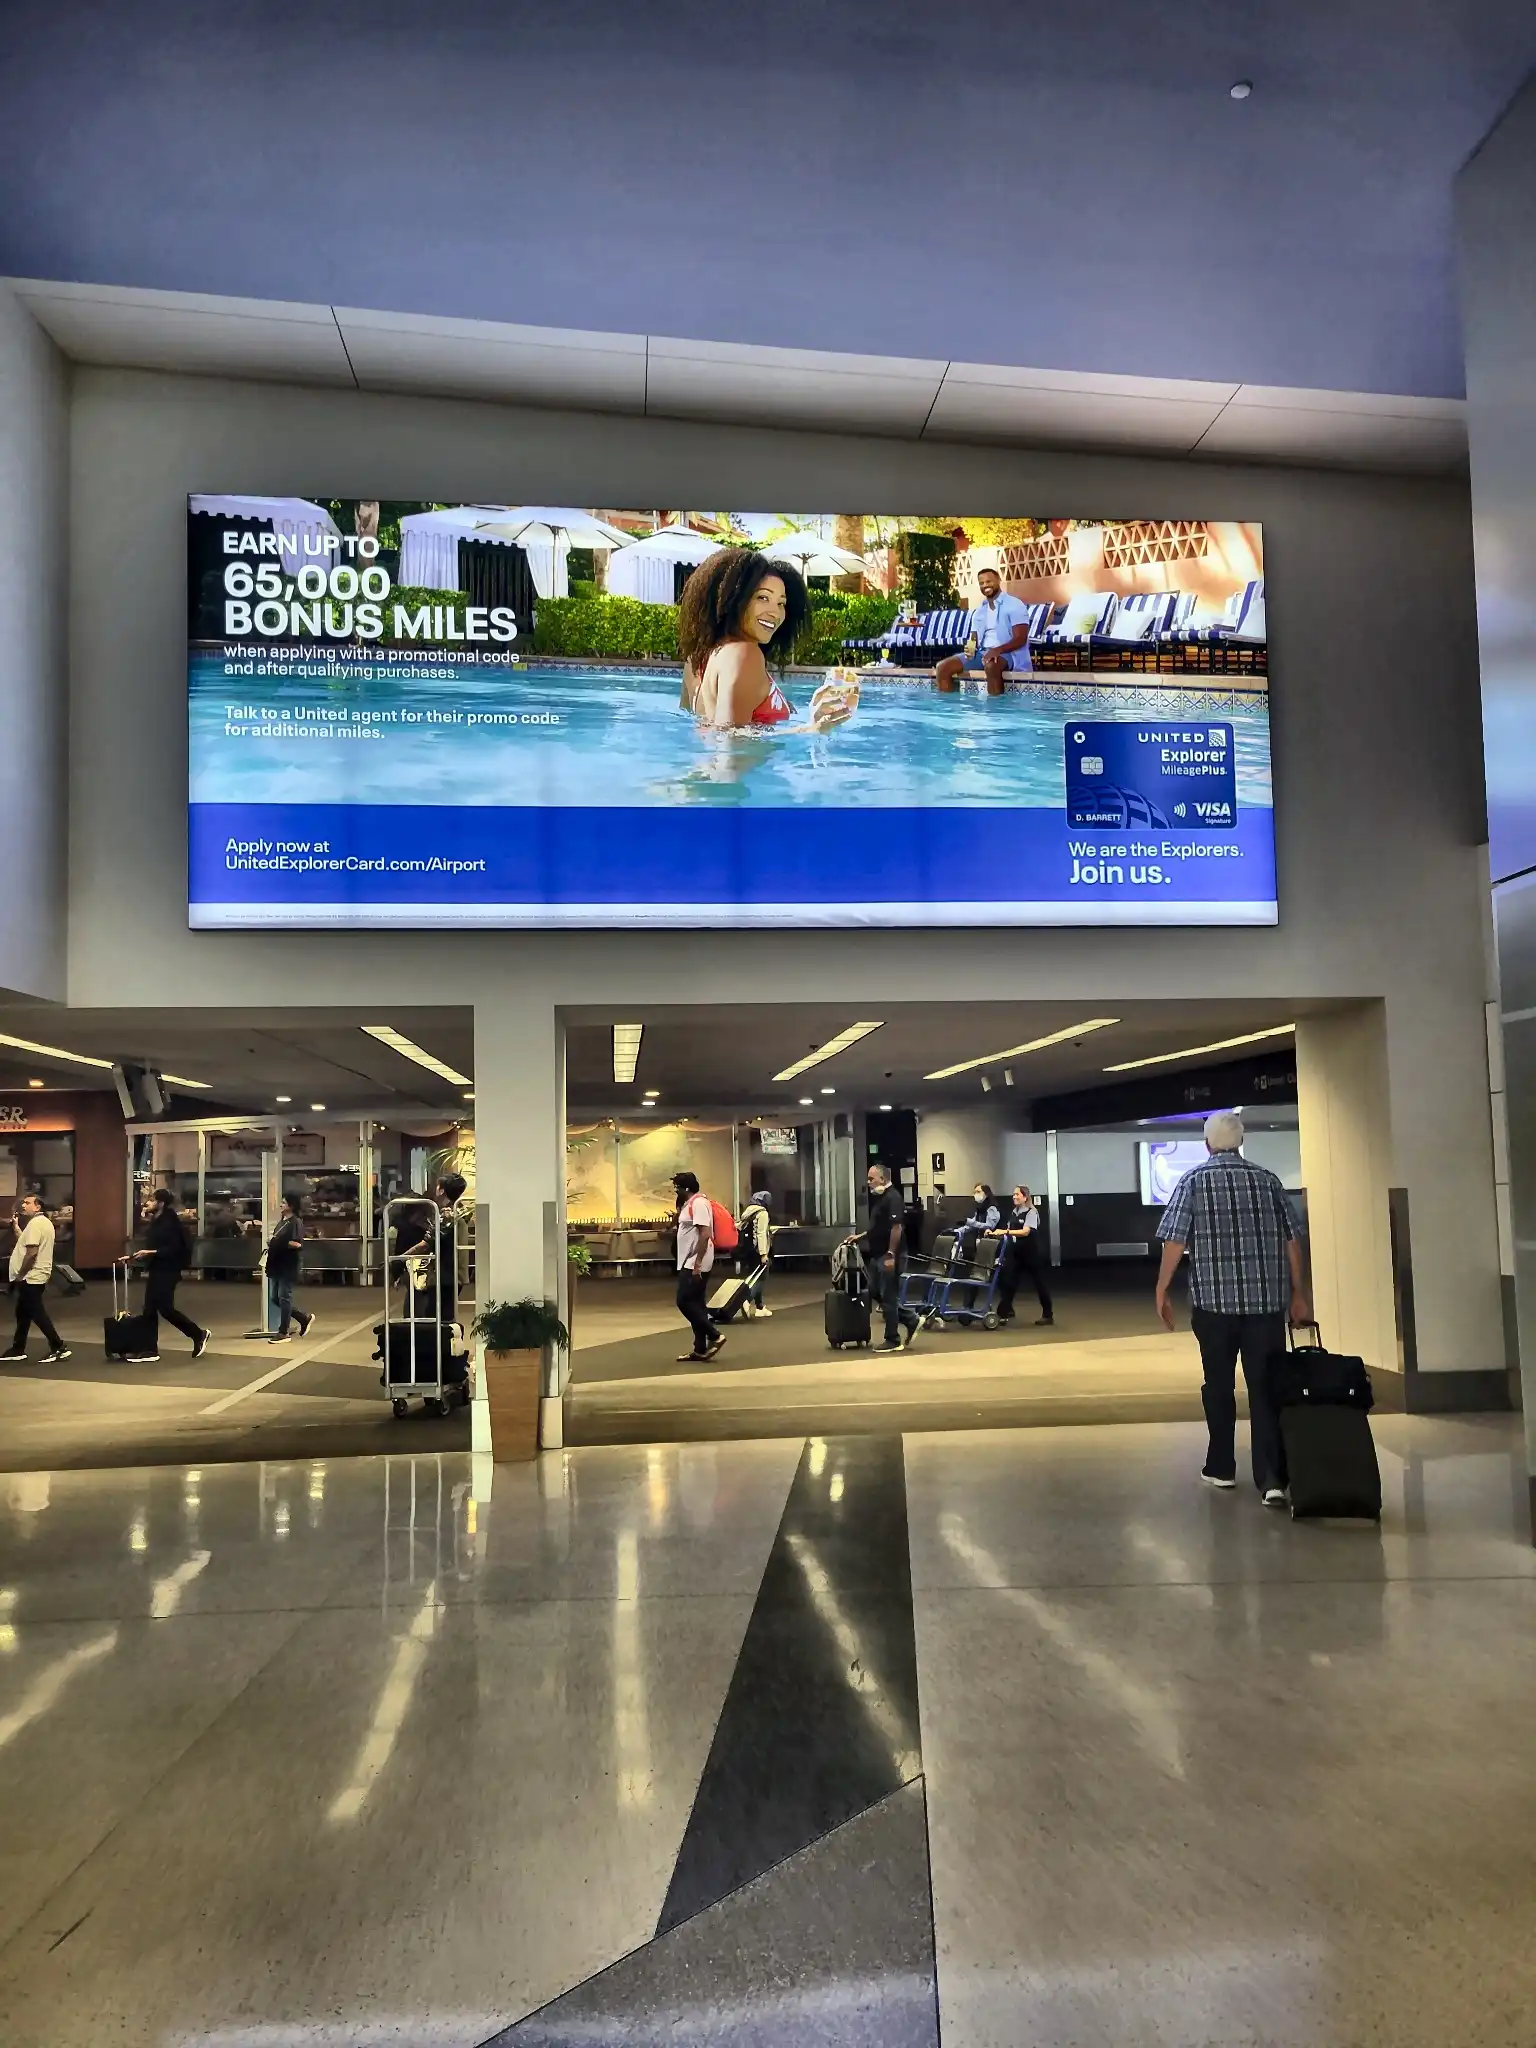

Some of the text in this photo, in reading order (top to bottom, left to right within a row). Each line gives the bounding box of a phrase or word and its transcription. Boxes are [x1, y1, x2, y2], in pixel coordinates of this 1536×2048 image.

[223, 531, 379, 558] EARN UP TO
[224, 561, 391, 601] 65,000
[225, 600, 518, 641] BONUS MILES
[224, 643, 520, 663] when applying with a promotional code
[224, 660, 460, 680] and after qualifying purchases.
[224, 705, 560, 726] Talk to a United agent for their promo code
[224, 723, 385, 738] for additional miles.
[1138, 732, 1204, 743] UNITED
[1161, 748, 1226, 764] Explorer
[1075, 814, 1121, 822] D. BARRETT
[1192, 802, 1231, 817] VISA
[1205, 817, 1231, 825] Signature
[225, 838, 330, 856] Apply now at
[1068, 841, 1244, 860] We are the Explorers.
[225, 855, 486, 874] UnitedExplorerCard.com/Airport
[1069, 859, 1172, 884] Join us.
